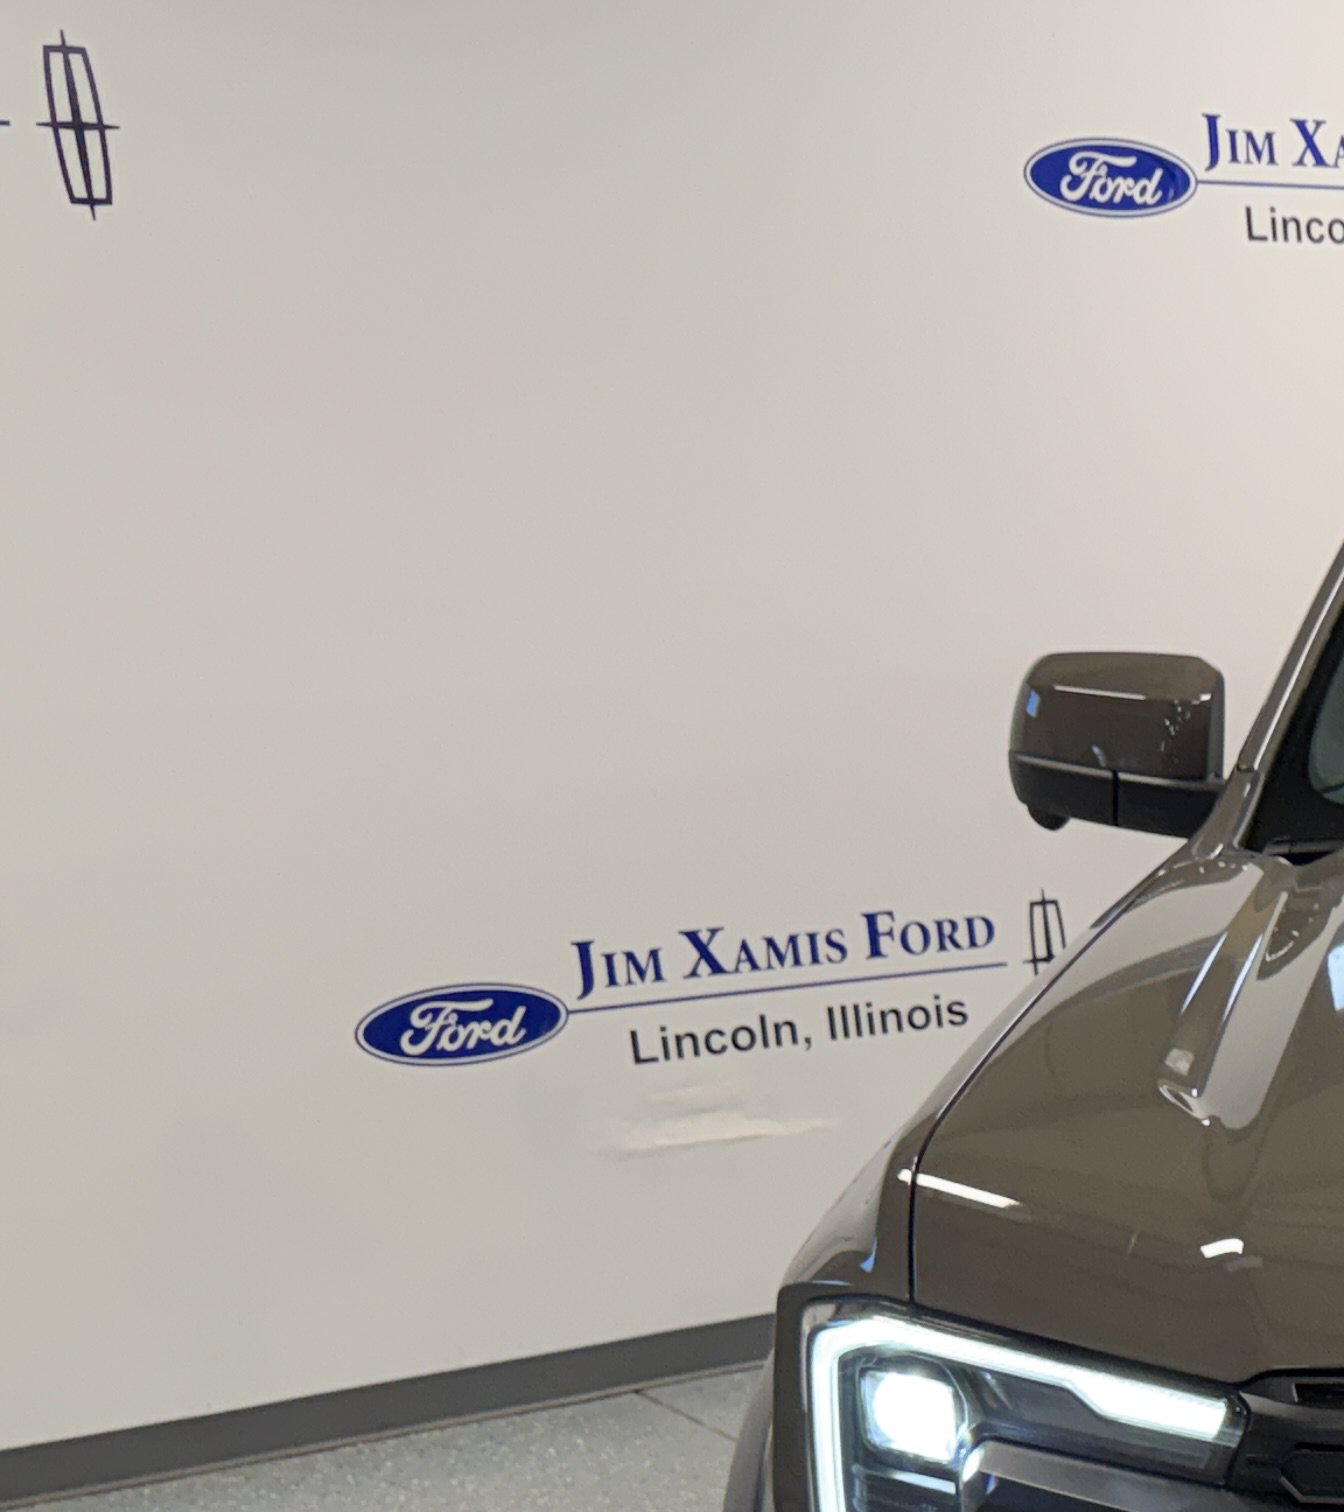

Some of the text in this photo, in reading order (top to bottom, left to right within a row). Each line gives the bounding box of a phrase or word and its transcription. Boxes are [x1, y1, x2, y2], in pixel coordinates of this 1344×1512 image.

[1060, 150, 1164, 206] Ford
[400, 998, 527, 1057] Ford
[630, 993, 969, 1066] Lincoln, Illinois
